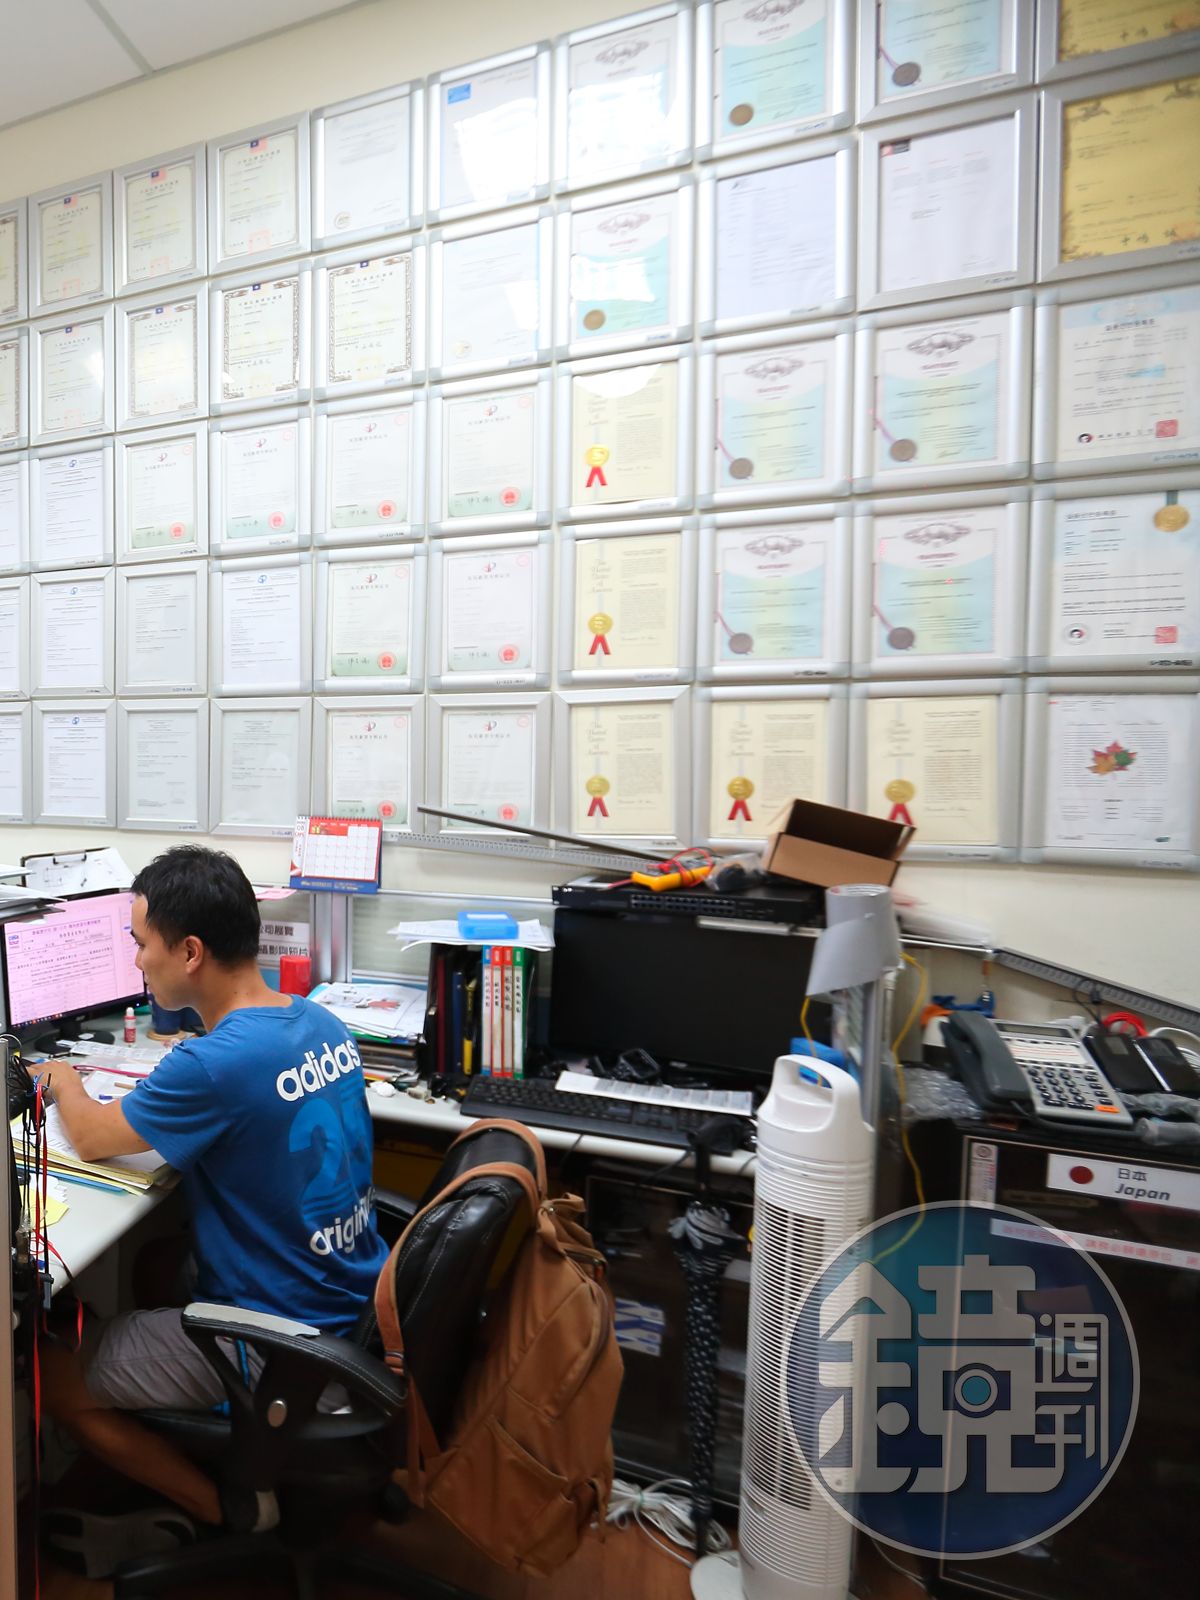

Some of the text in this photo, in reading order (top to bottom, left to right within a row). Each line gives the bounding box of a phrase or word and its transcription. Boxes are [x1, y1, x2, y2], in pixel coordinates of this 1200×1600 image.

[276, 1039, 361, 1102] adidas
[1118, 1167, 1147, 1182] 日本
[1115, 1183, 1171, 1201] Japan
